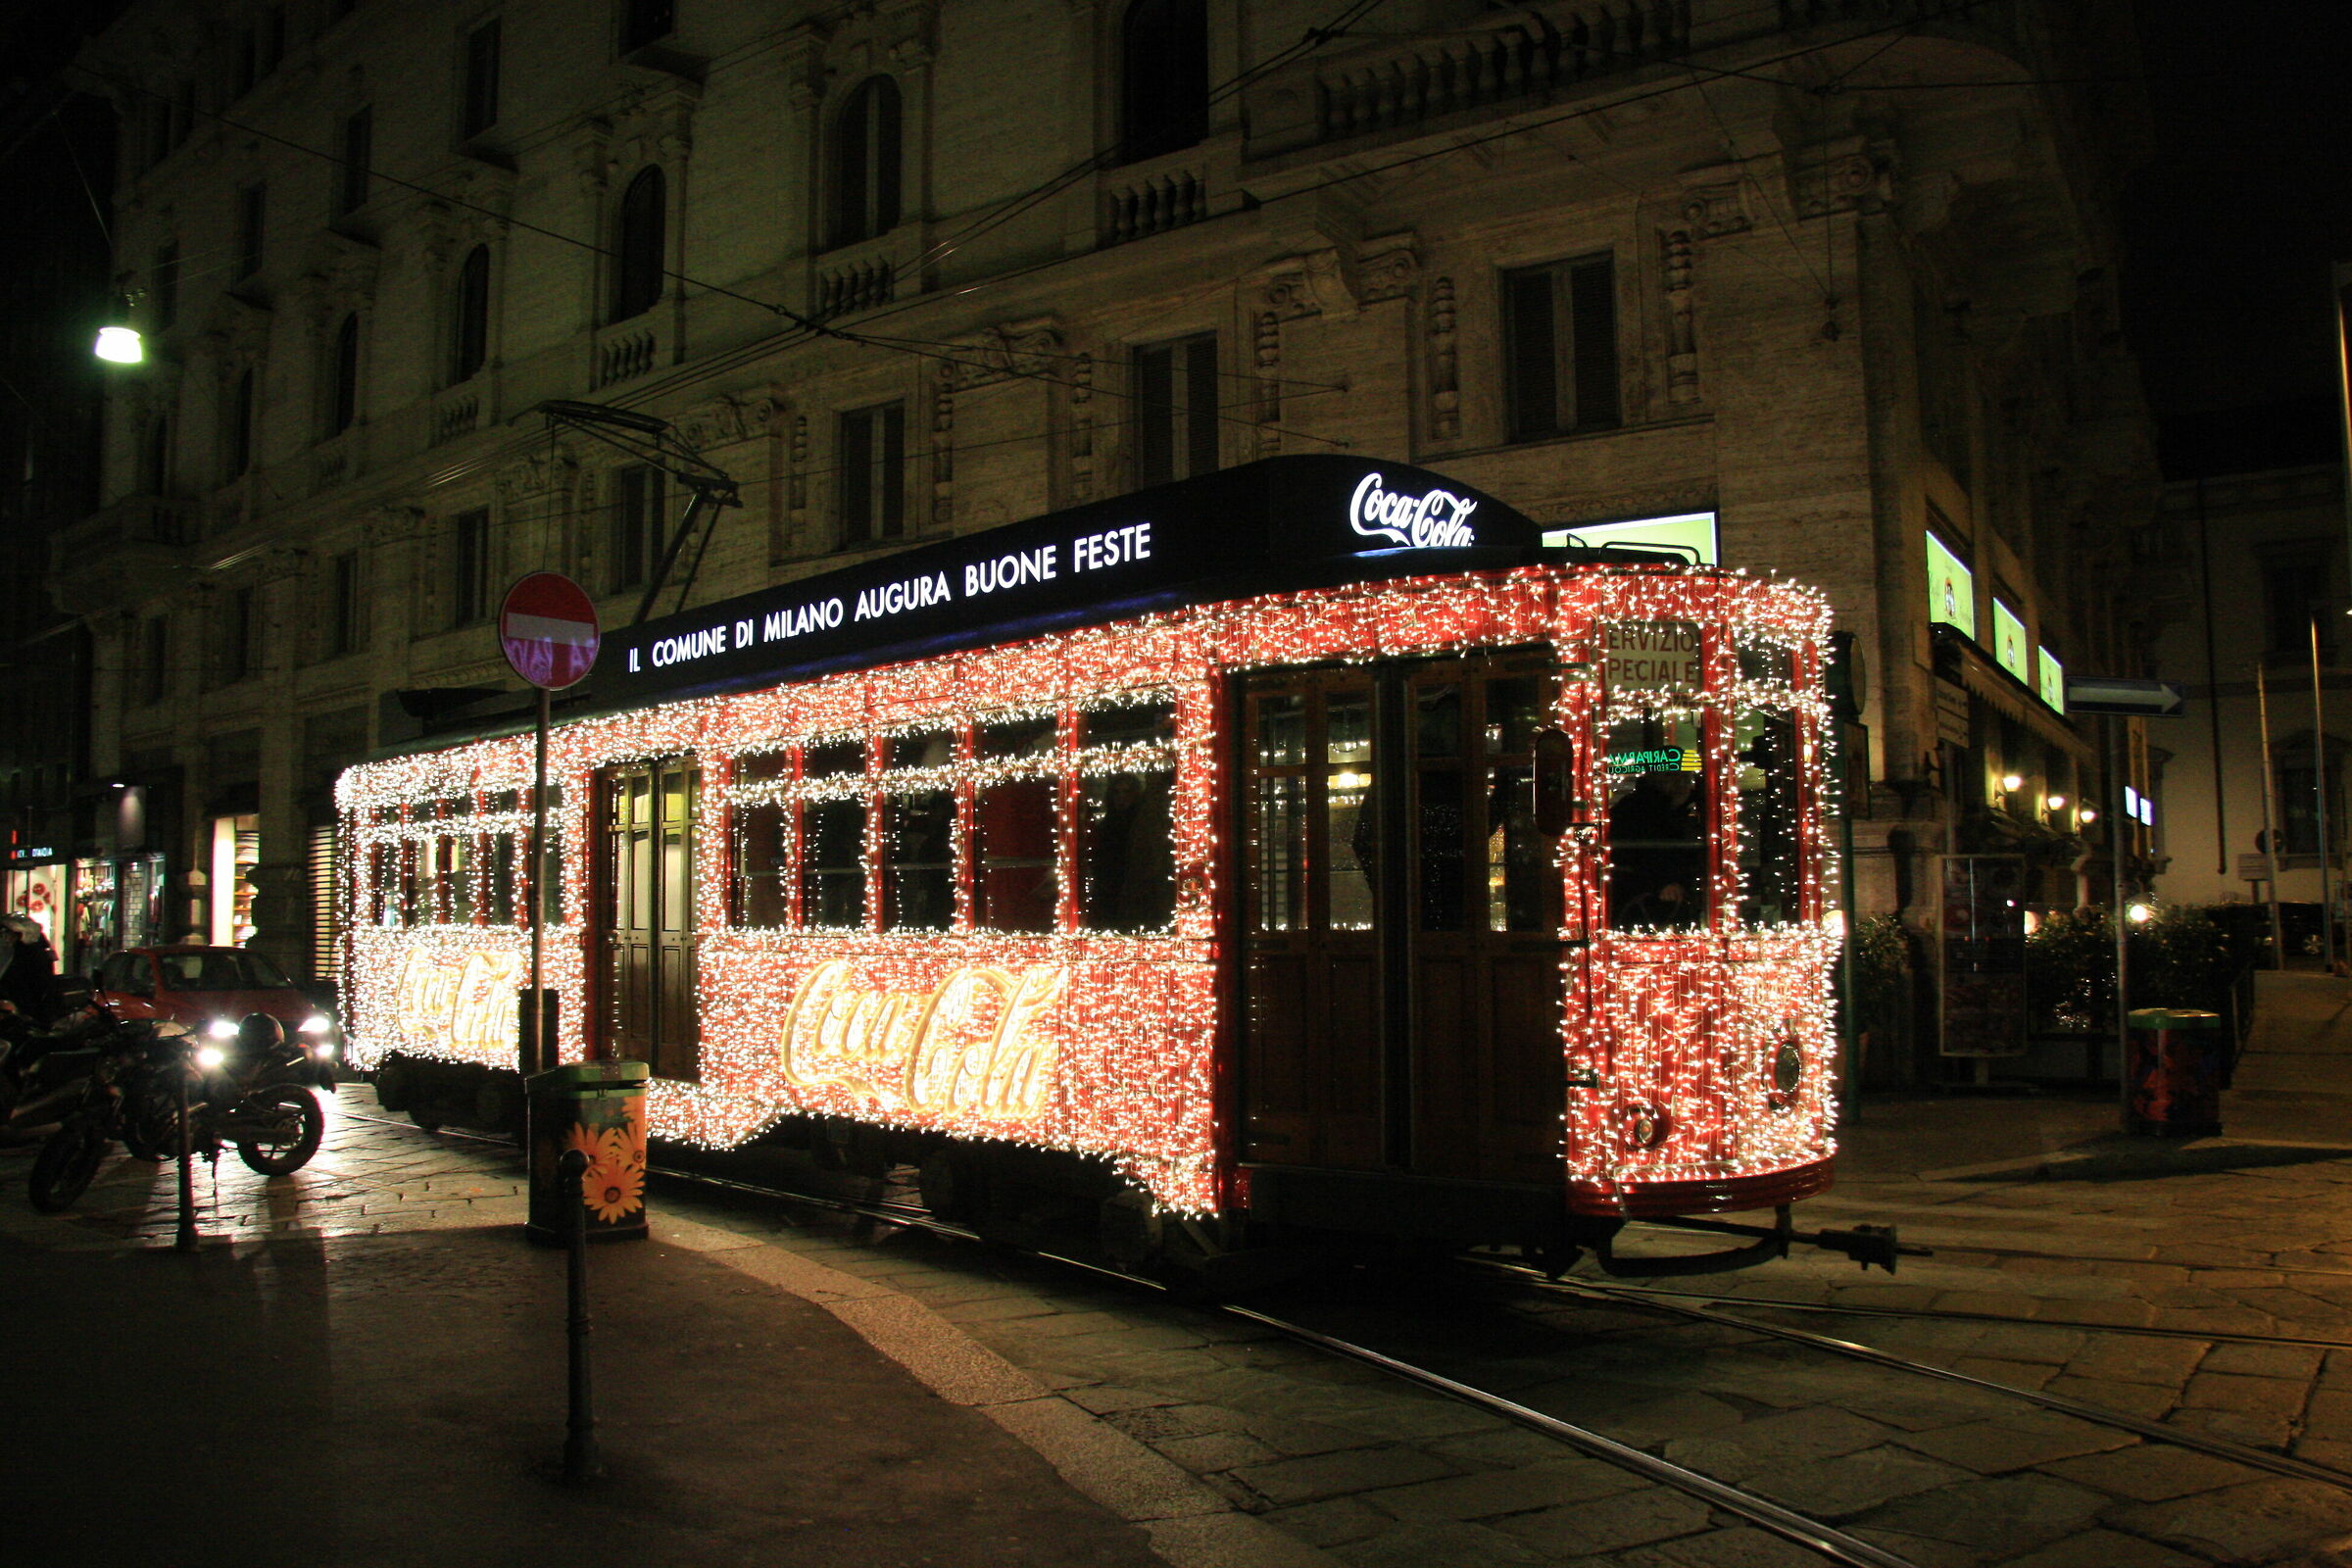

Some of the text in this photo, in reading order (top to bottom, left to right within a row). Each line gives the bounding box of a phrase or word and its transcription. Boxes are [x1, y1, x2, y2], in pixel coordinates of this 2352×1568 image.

[1349, 472, 1478, 547] Coca-Cola
[628, 647, 641, 673] IL
[652, 625, 726, 667] COMUNE
[735, 618, 754, 649] DI
[763, 598, 844, 643] MILANO
[854, 570, 952, 622] AUGURA
[964, 545, 1056, 597] BUONE
[1074, 522, 1152, 573] FESTE
[1607, 658, 1696, 684] PECIALE
[1608, 627, 1694, 652] ERVIZIO
[781, 959, 1069, 1120] Coca-Cola
